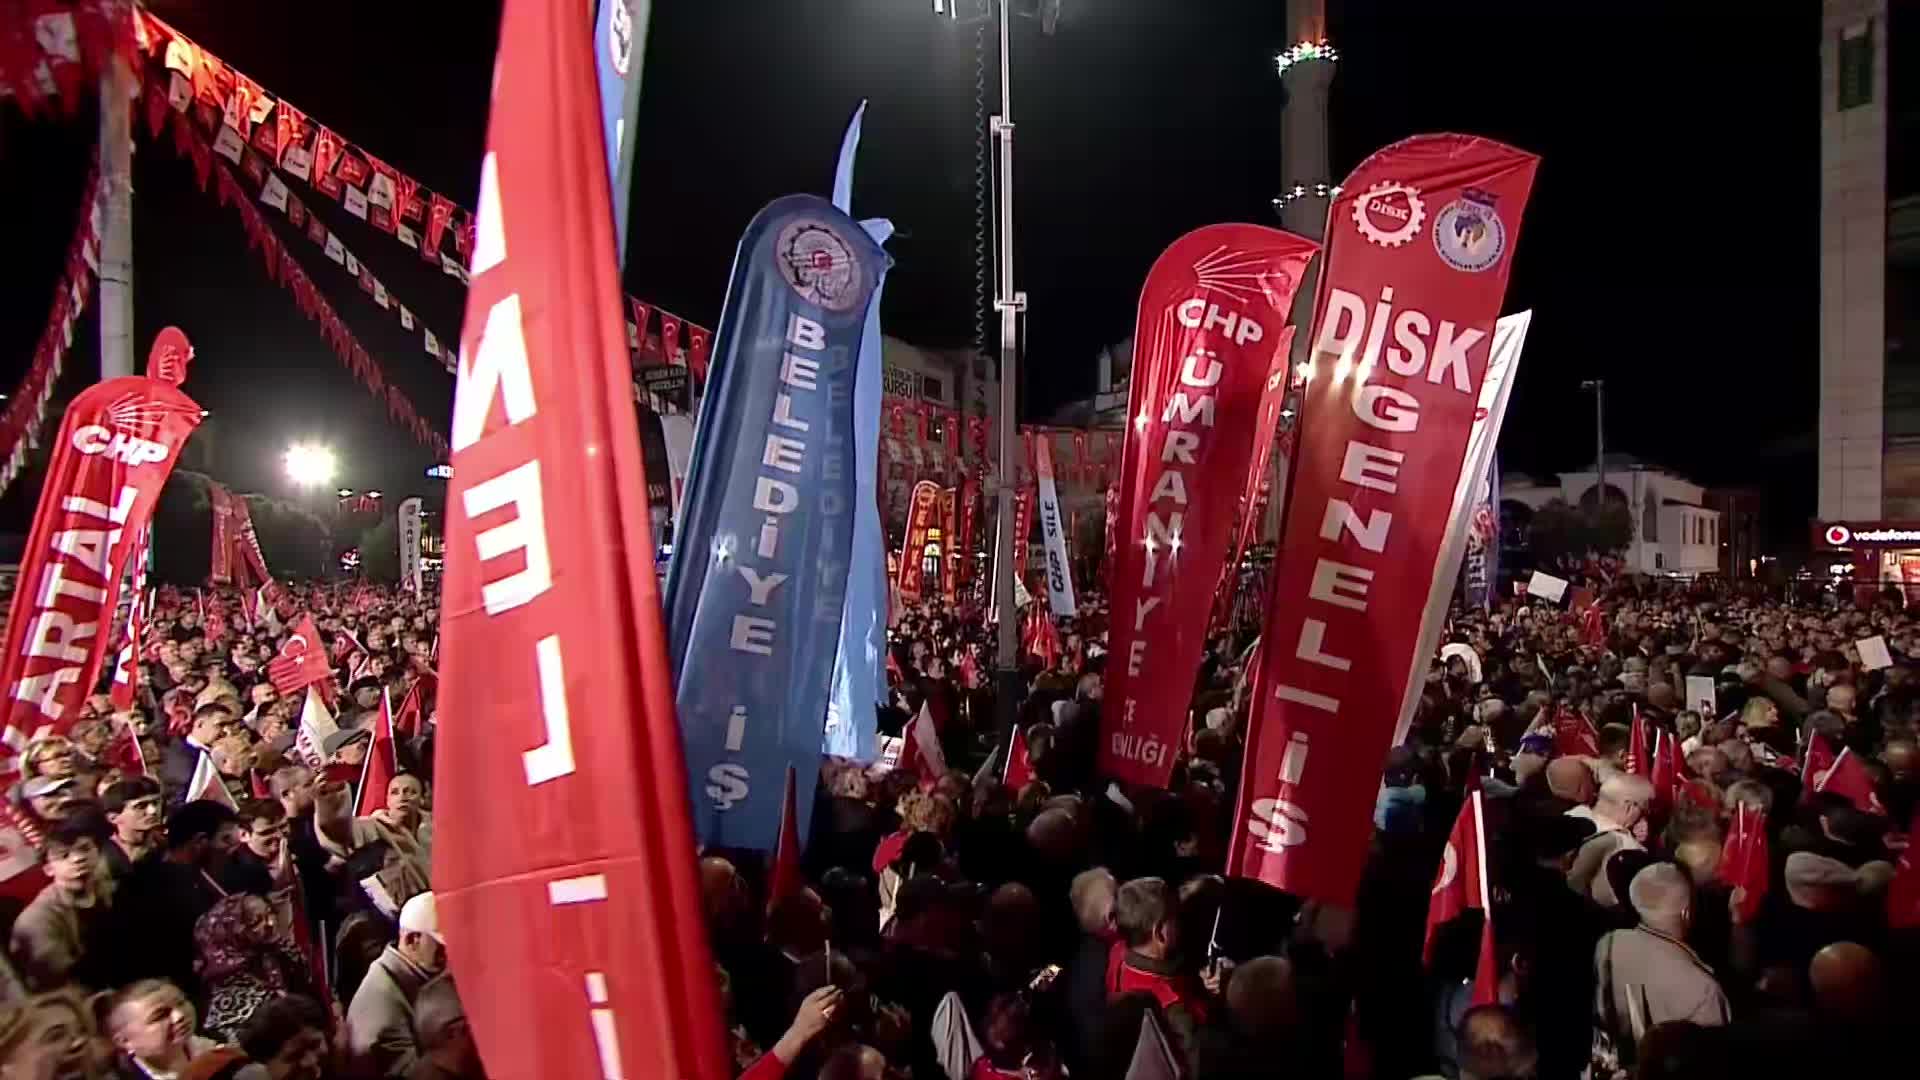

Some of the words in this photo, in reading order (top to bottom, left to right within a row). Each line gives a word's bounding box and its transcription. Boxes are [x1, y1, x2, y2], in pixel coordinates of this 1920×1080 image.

[1177, 299, 1263, 346] CHP
[1312, 286, 1486, 393] DİSK
[72, 424, 168, 466] CHP
[730, 312, 825, 657] BELEDİYE
[1050, 550, 1065, 593] CHP
[706, 705, 749, 810] İŞ
